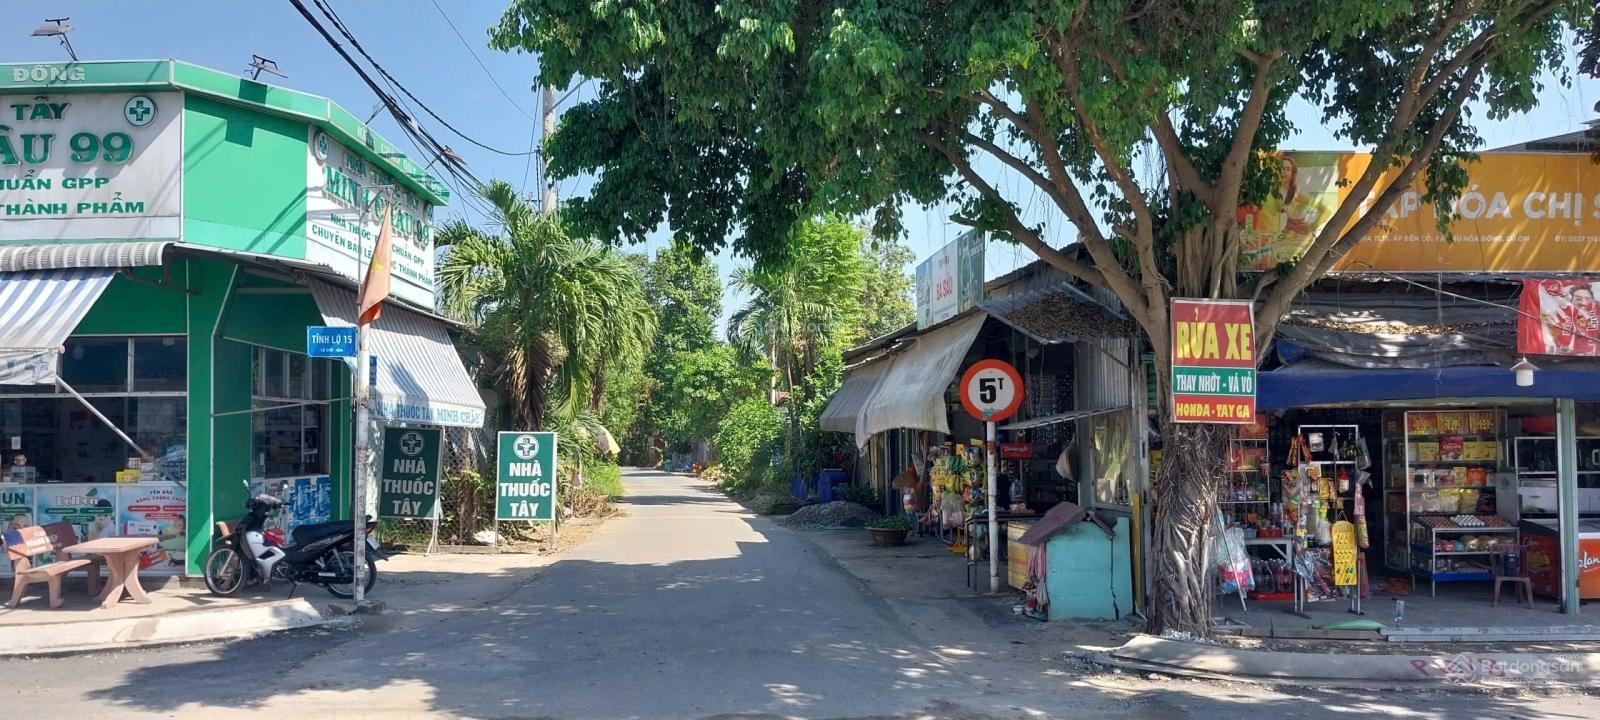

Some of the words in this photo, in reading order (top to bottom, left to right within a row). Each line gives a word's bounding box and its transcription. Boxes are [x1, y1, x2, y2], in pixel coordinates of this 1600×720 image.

[10, 96, 71, 121] TÂY
[69, 131, 134, 165] 99
[62, 177, 110, 190] GPP
[77, 192, 145, 215] PHẨM
[1523, 191, 1582, 226] CHỊ
[330, 212, 347, 228] NHÀ
[374, 195, 414, 236] CÂU
[311, 224, 346, 248] CHUYÊN
[413, 255, 425, 268] GPP
[311, 332, 330, 344] TỈNH
[343, 335, 353, 344] 15
[1176, 307, 1220, 359] RỬA
[1224, 323, 1252, 360] XE
[1176, 374, 1197, 392] THAY
[1198, 371, 1221, 392] NHỚT
[1228, 372, 1239, 393] VÁ
[1241, 370, 1252, 393] VỎ
[397, 401, 421, 419] THUỐC
[435, 407, 459, 423] MINH
[1176, 403, 1211, 417] HONDA
[1216, 404, 1235, 418] TAY
[1236, 404, 1250, 418] GA
[393, 456, 427, 474] NHÀ
[509, 459, 543, 477] NHÀ
[383, 475, 434, 495] THUỐC
[499, 479, 551, 498] THUỐC
[392, 499, 422, 516] TÂY
[509, 499, 540, 518] TÂY
